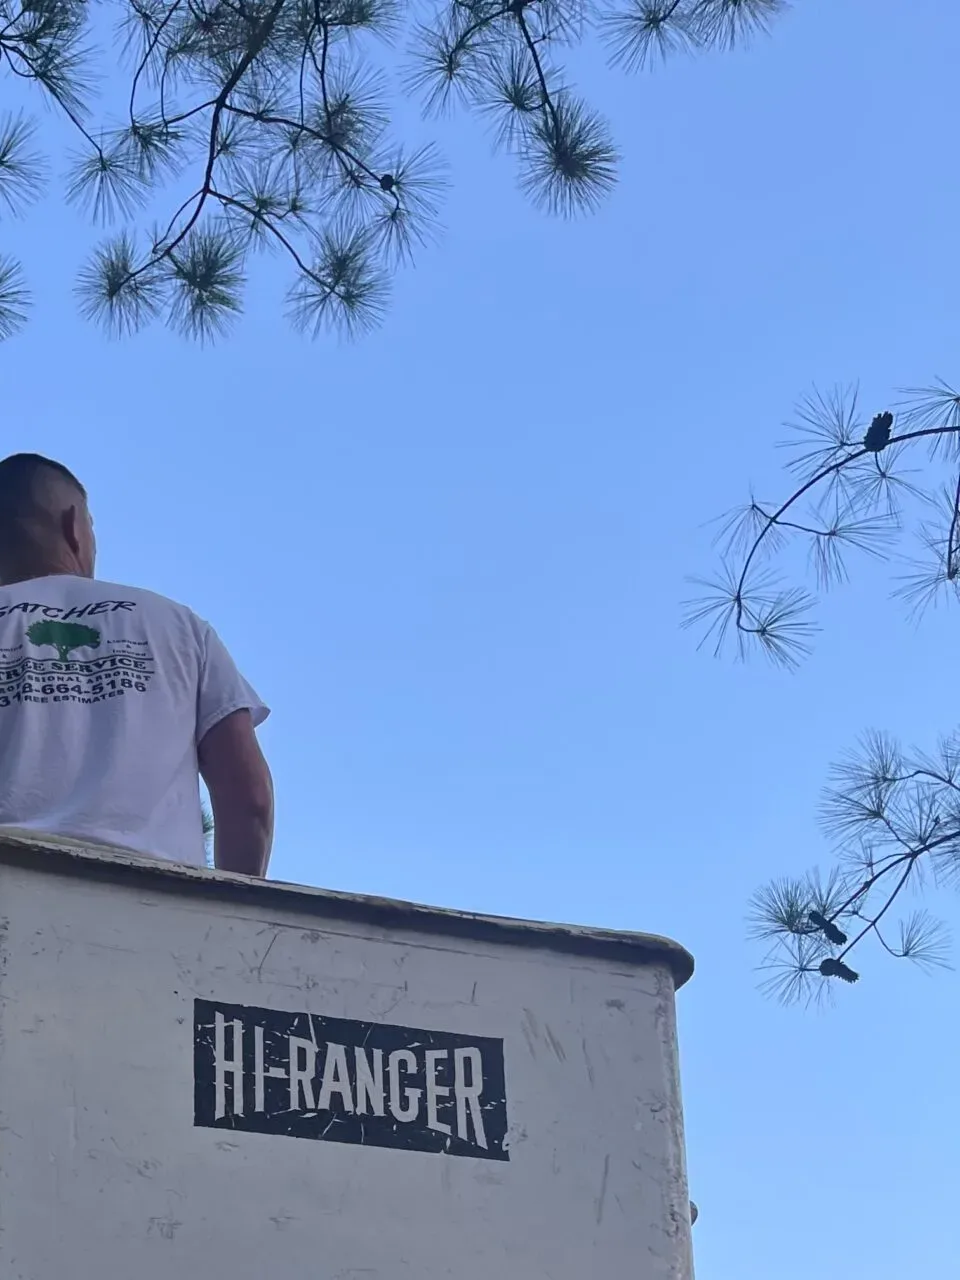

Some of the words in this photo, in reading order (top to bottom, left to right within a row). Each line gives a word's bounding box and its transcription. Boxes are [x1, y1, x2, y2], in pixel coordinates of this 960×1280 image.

[51, 658, 146, 673] SERVICE
[86, 670, 152, 685] ARBORIST
[21, 694, 49, 703] REE
[53, 689, 125, 704] ESTIMATES
[213, 1010, 489, 1151] HI-RANGER
